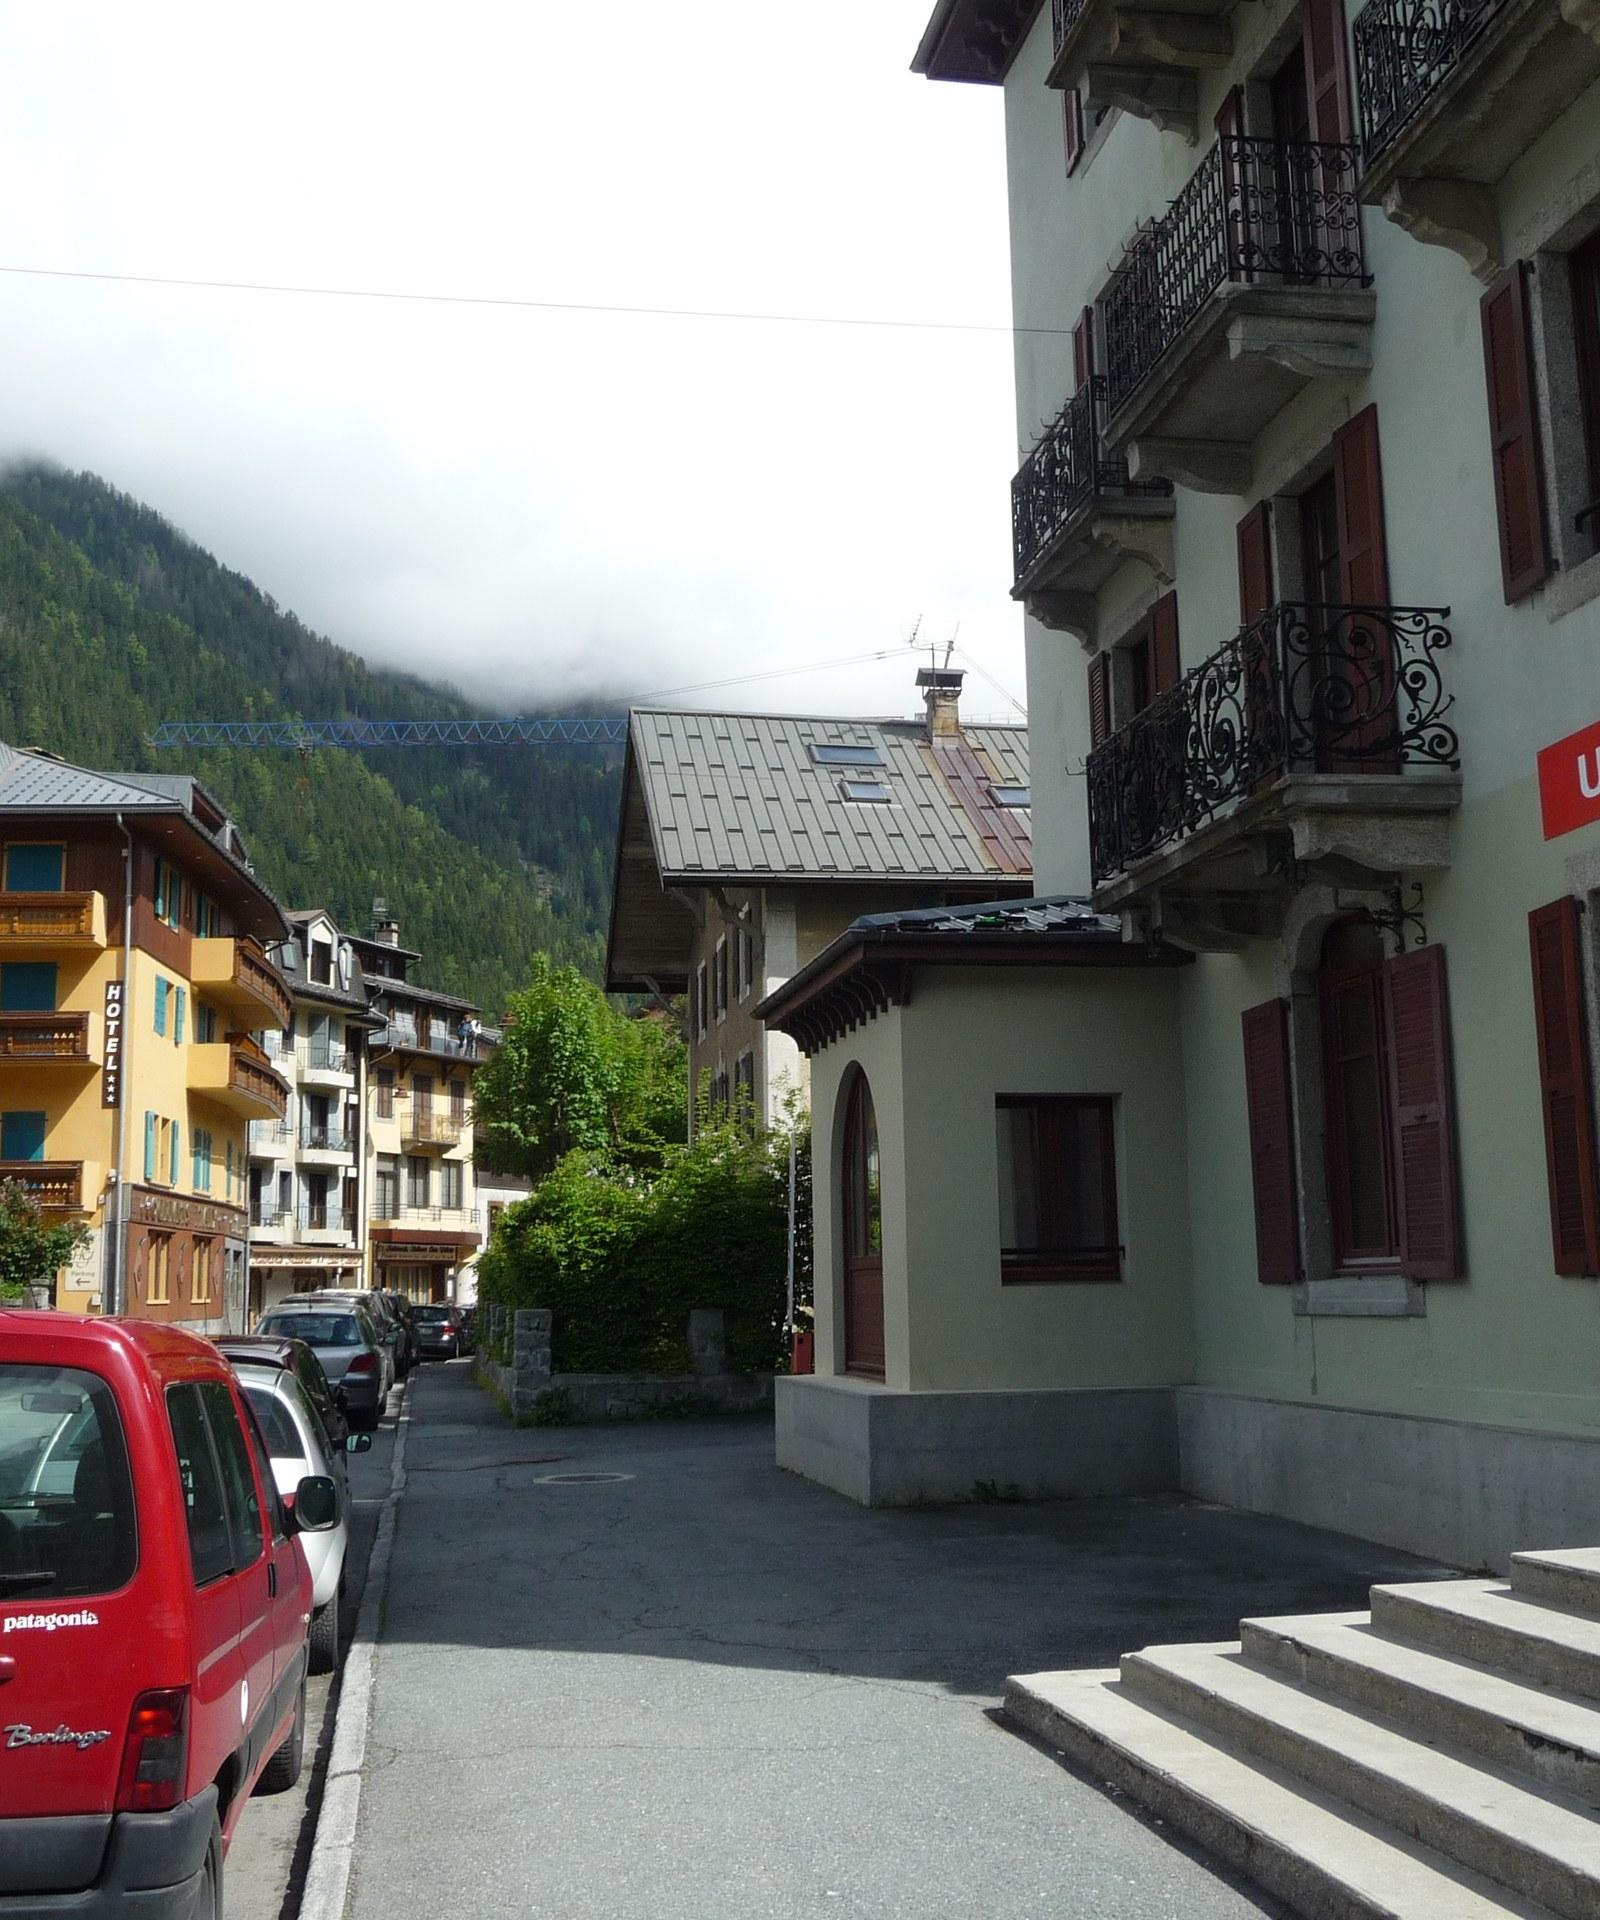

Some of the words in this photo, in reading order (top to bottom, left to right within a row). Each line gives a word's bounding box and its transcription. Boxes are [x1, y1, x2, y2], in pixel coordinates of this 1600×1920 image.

[106, 985, 121, 1070] HOTEL
[3, 1610, 99, 1633] patagonia
[4, 1723, 111, 1749] Berlingo
